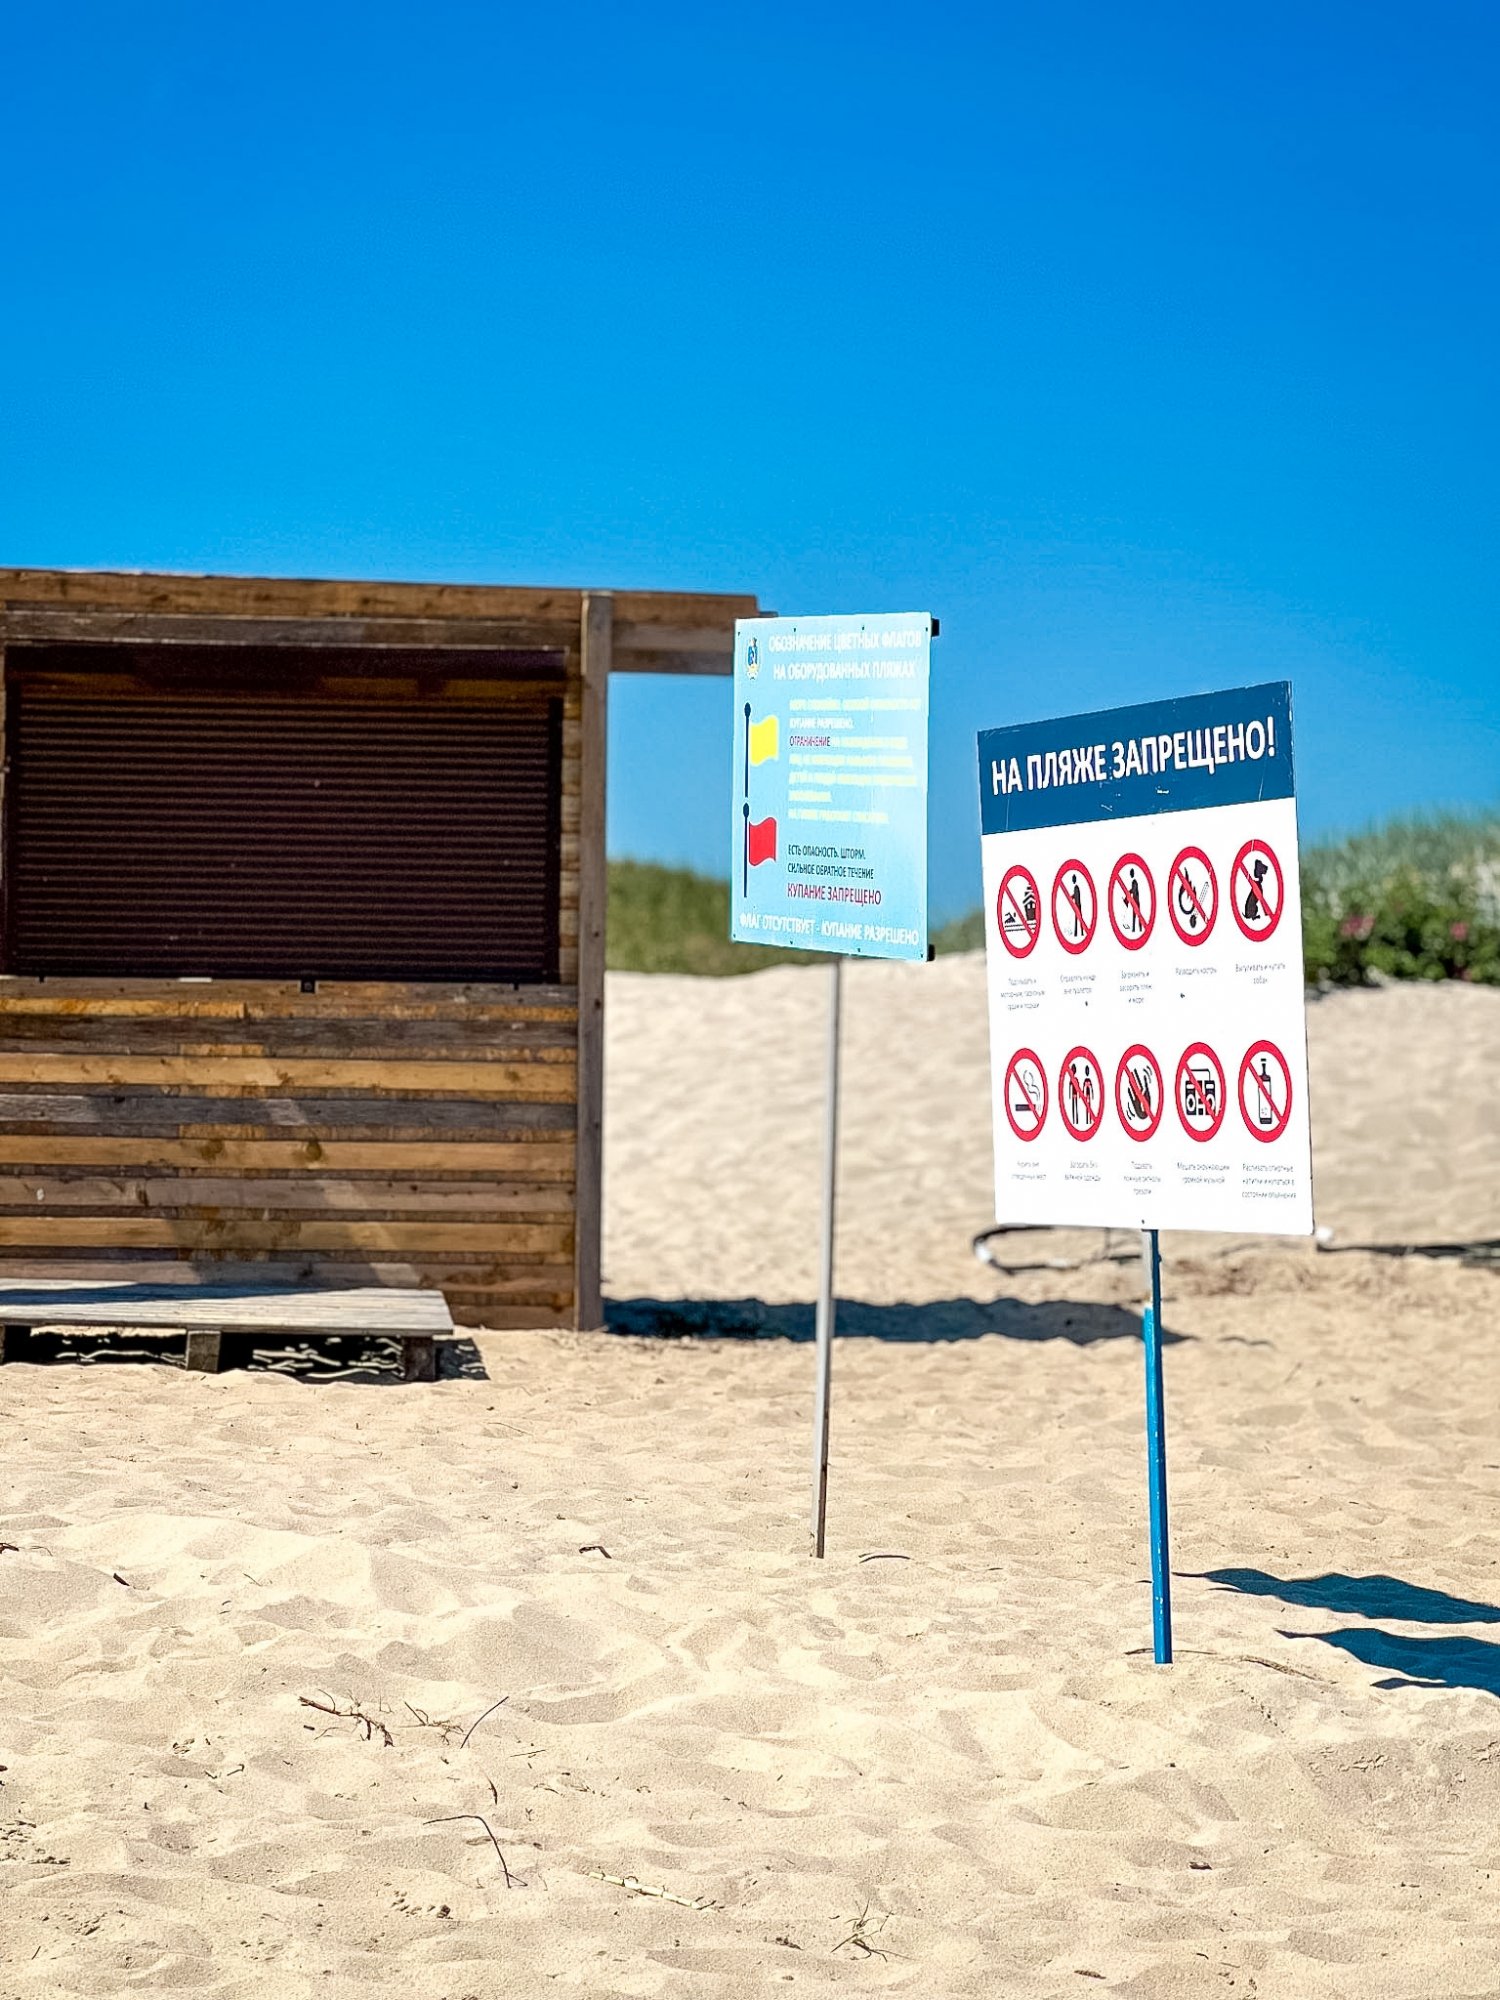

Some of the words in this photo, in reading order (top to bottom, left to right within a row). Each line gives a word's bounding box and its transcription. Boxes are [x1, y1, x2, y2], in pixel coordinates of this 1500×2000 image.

[768, 633, 832, 652] ОБОЗНАЧЕНИЕ
[834, 632, 879, 653] ЦВЕТНЫХ
[881, 630, 921, 648] ФЛАГОВ
[773, 663, 786, 680] НА
[787, 662, 870, 683] ОБОРУДОВАННЫХ
[872, 660, 915, 679] ПЛЯЖАХ
[992, 756, 1023, 796] НА
[1026, 745, 1107, 791] ПЛЯЖЕ
[1111, 716, 1275, 779] ЗАПРЕЩЕНО!
[788, 844, 801, 856] ЕСТЬ
[787, 862, 815, 875] СИЛЬНОЕ
[815, 865, 847, 878] ОБРАТНОЕ
[847, 866, 874, 879] ТЕЧЕНИЕ
[787, 883, 825, 900] КУПАНИЕ
[827, 886, 882, 906] ЗАПРЕЩЕНО
[739, 912, 761, 929] ФЛАГ
[762, 914, 816, 935] ОТСУТСТВУЕТ
[821, 920, 863, 940] КУПАНИЕ
[863, 924, 919, 945] РАЗРЕШЕНО
